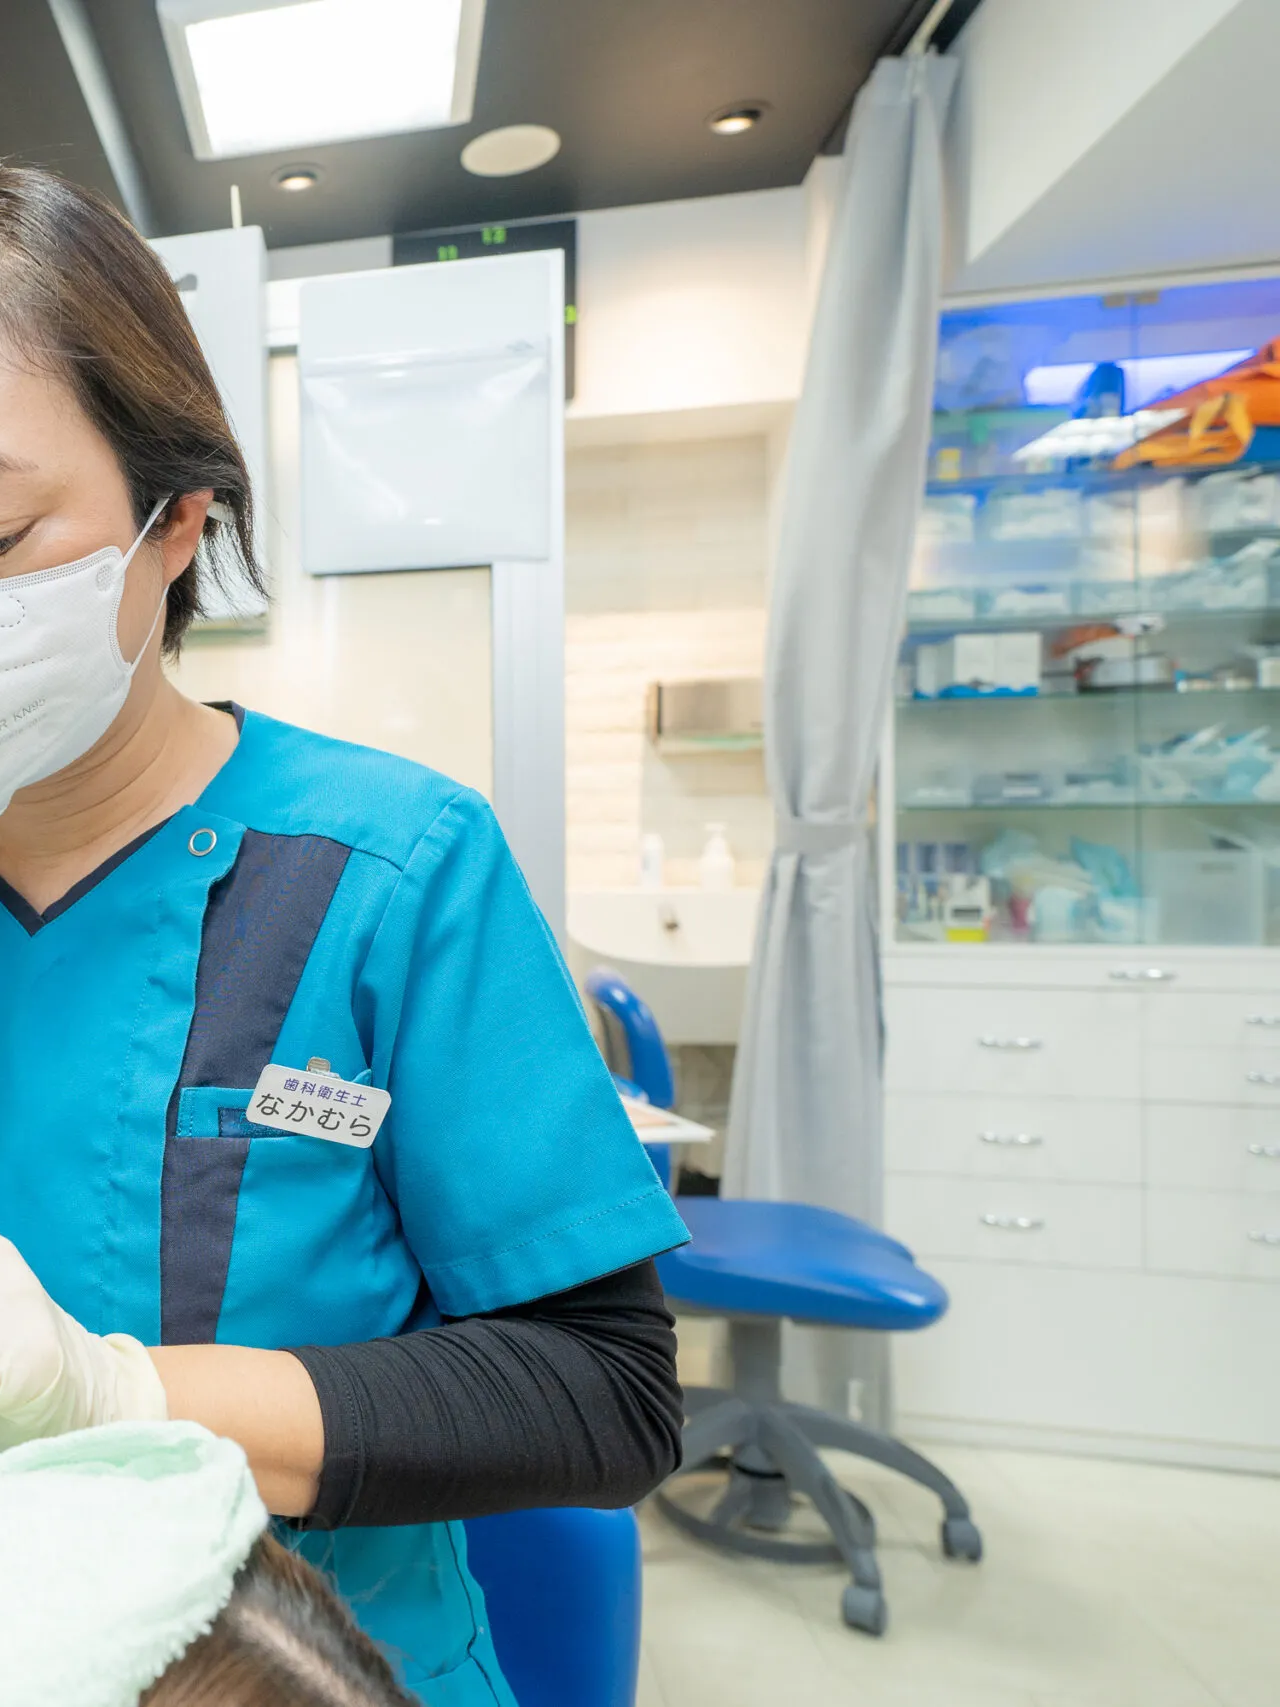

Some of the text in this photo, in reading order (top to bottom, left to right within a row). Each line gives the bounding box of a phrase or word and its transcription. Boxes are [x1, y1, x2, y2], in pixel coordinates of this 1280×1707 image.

[283, 1078, 367, 1108] 歯科衛生士
[256, 1093, 372, 1137] なかむら
